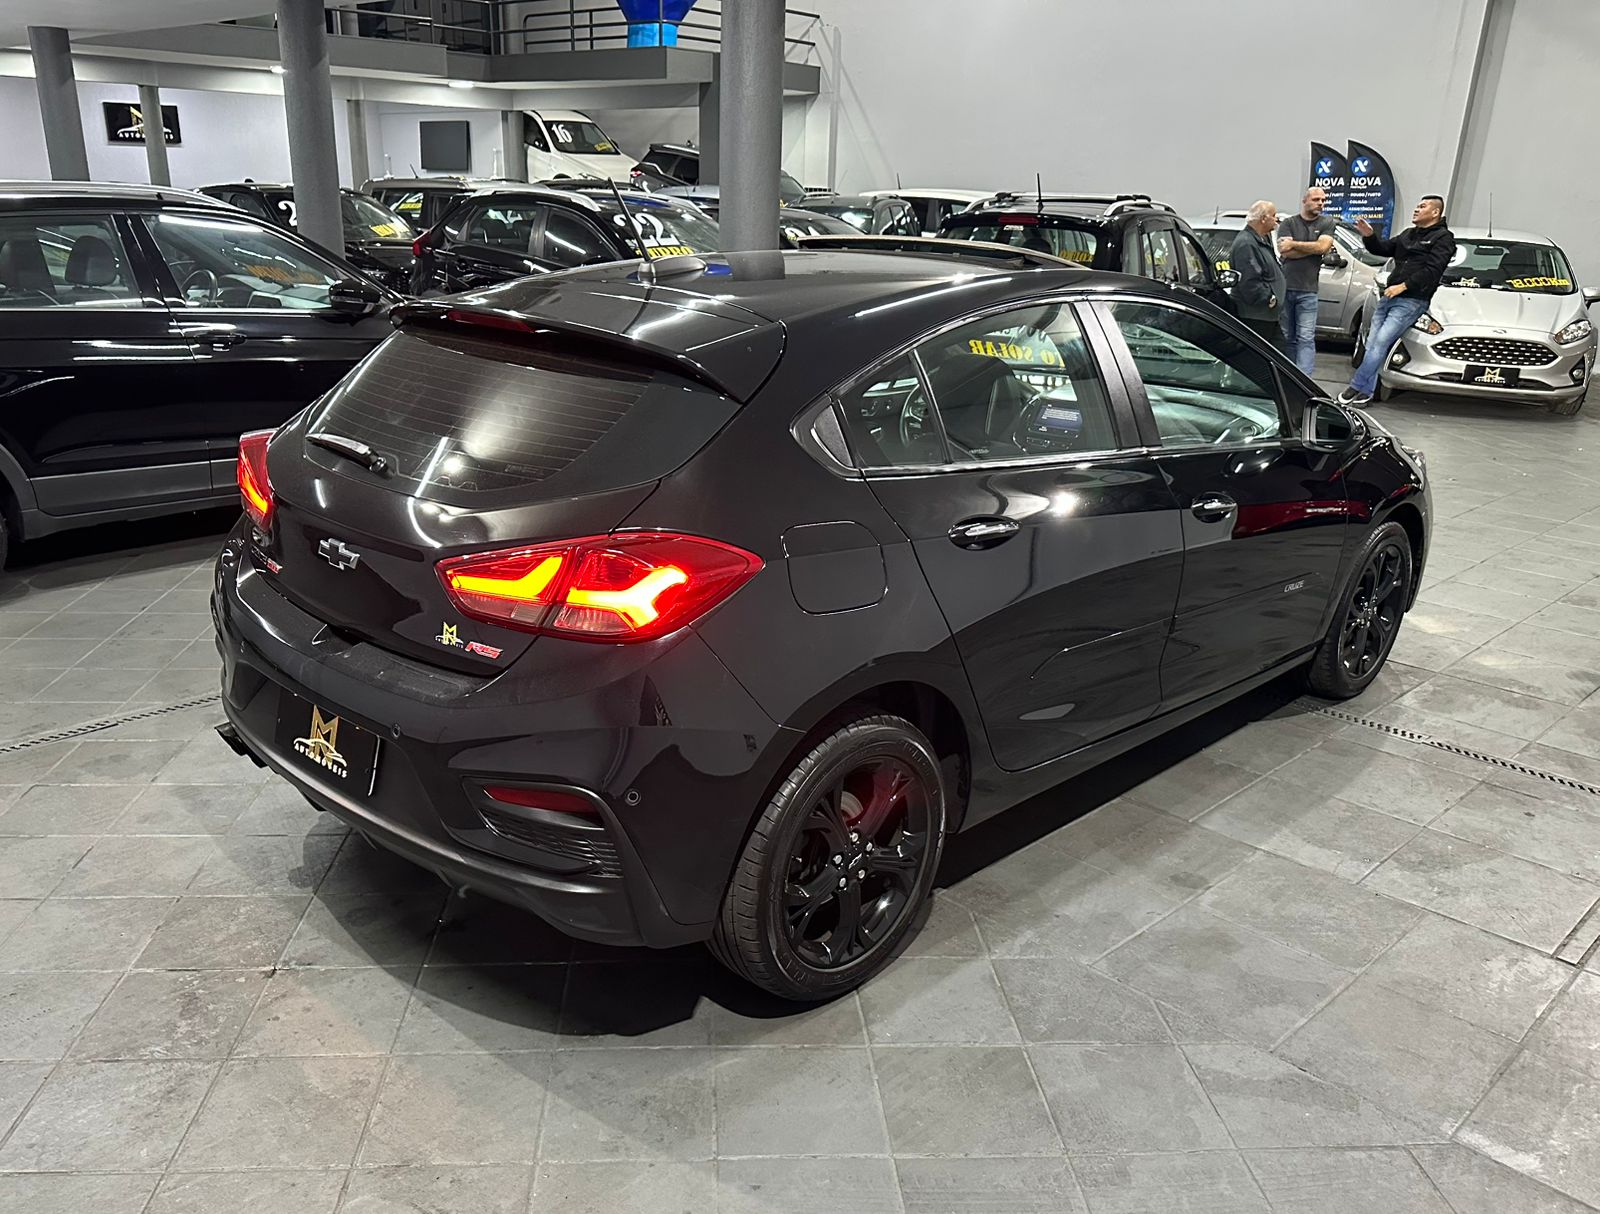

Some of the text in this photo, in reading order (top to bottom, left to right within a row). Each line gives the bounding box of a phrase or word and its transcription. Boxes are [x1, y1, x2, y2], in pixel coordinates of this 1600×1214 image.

[551, 124, 573, 143] 16
[1315, 177, 1344, 186] NOVA
[1350, 177, 1381, 186] NOVA
[613, 212, 681, 248] 22
[464, 641, 504, 659] RS
